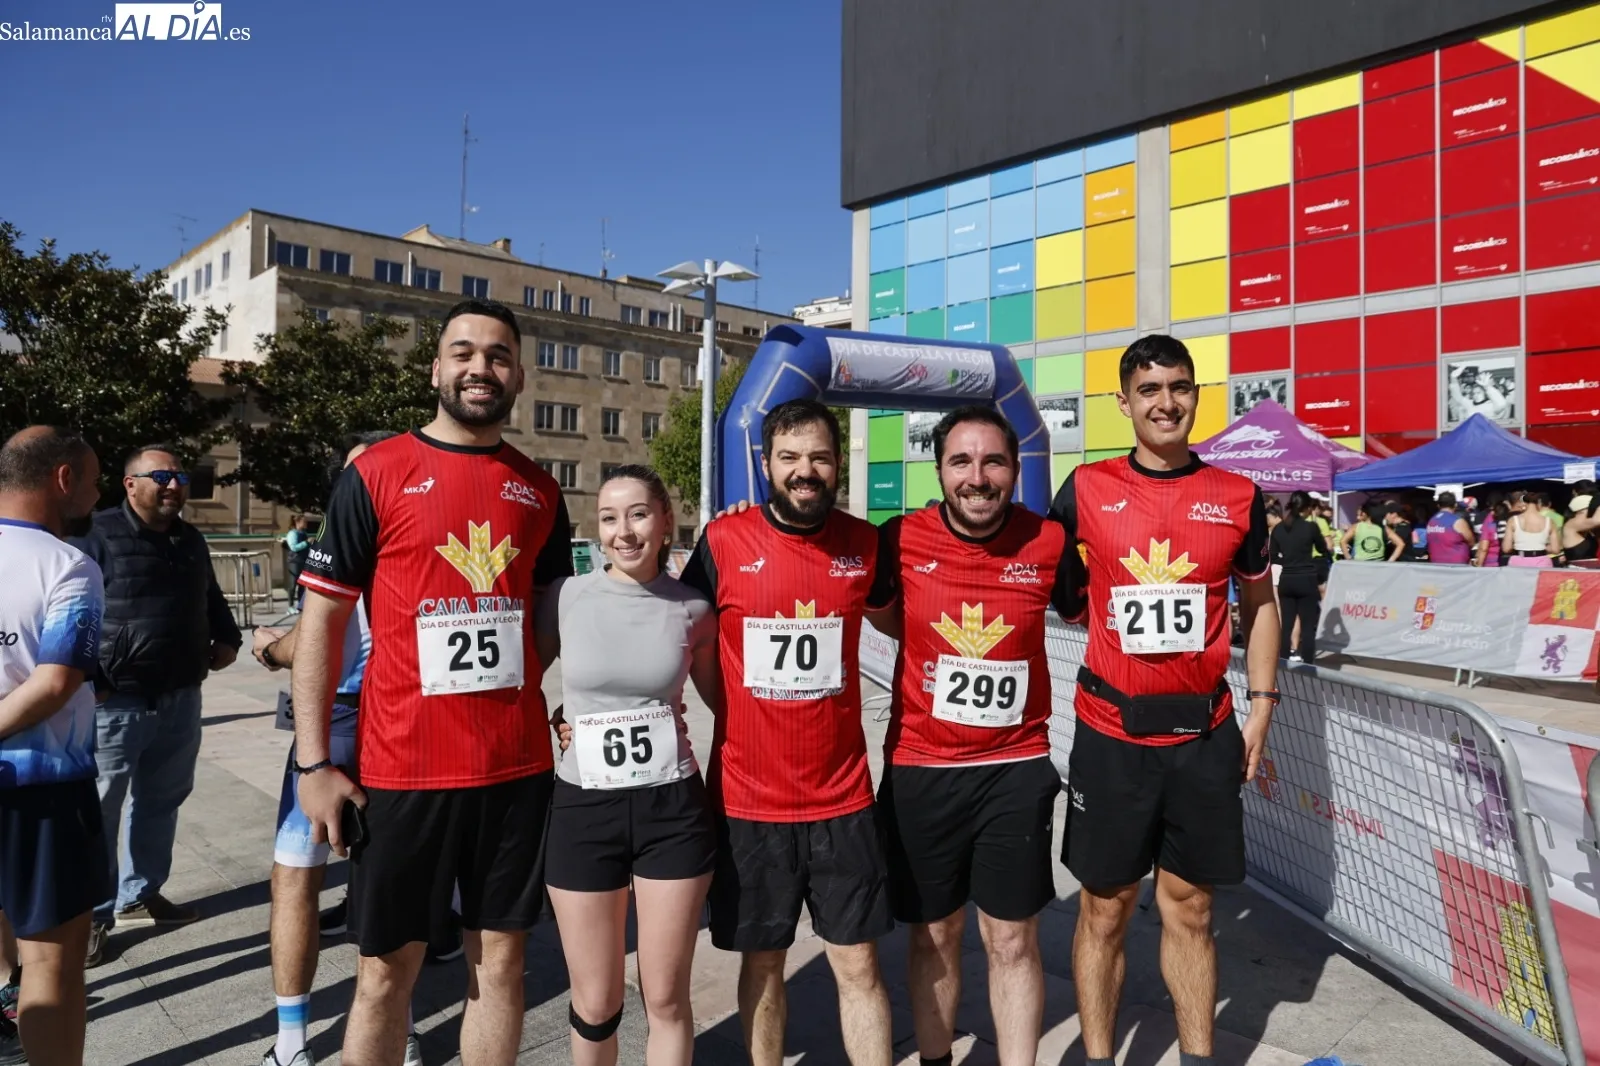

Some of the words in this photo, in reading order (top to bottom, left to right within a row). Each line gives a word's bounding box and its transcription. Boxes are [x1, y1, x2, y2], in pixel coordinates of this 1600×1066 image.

[834, 342, 862, 355] DÍA
[863, 344, 882, 357] DE
[883, 346, 945, 361] CASTILLA
[1191, 502, 1228, 517] ADAS
[1188, 513, 1203, 521] Club
[831, 556, 863, 569] ADAS
[1004, 563, 1039, 576] ADAS
[999, 575, 1014, 583] Club
[1140, 588, 1175, 596] CASTILLA
[1124, 599, 1193, 635] 215
[421, 621, 437, 630] DÍA
[438, 620, 450, 628] DE
[452, 618, 492, 627] CASTILLA
[820, 621, 840, 629] LEÓN
[447, 629, 500, 671] 25
[770, 634, 818, 671] 70
[941, 658, 955, 666] DÍA
[957, 661, 967, 669] DE
[968, 663, 1004, 672] CASTILLA
[946, 671, 1017, 709] 299
[607, 715, 644, 724] CASTILLA
[603, 725, 653, 767] 65
